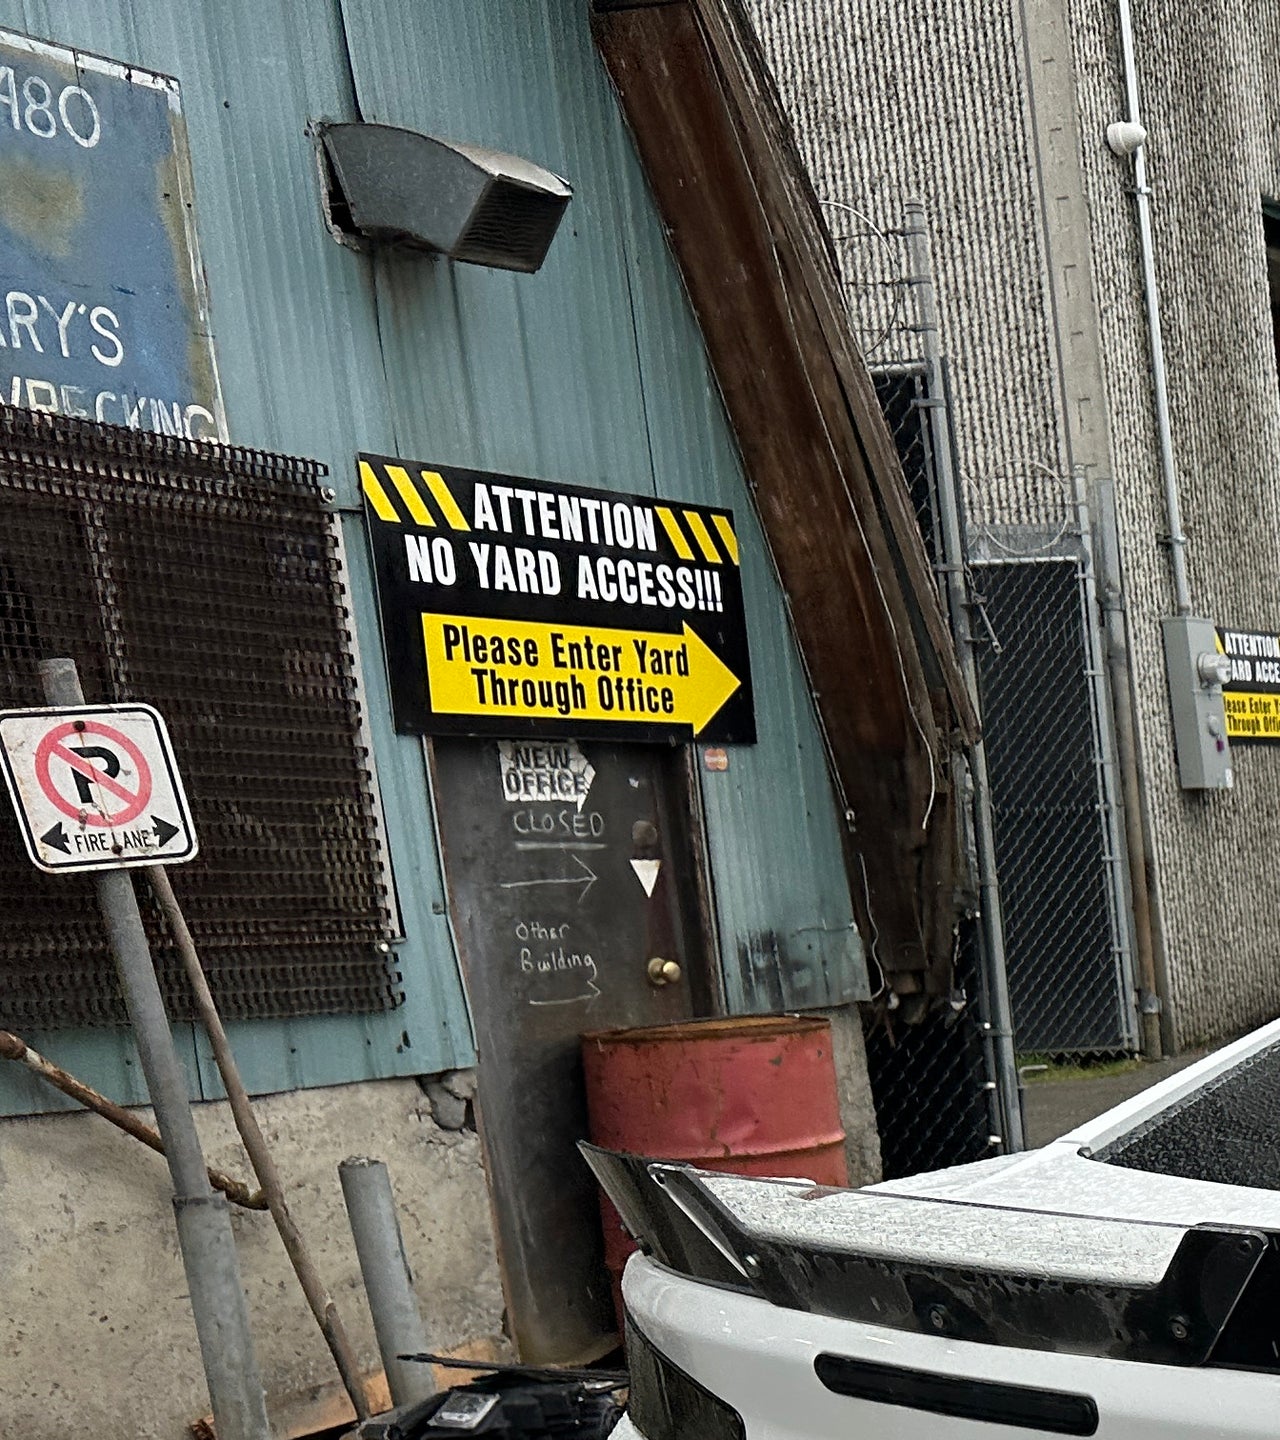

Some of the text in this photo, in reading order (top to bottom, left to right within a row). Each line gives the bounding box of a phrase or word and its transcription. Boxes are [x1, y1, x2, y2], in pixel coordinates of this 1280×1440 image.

[0, 291, 124, 367] RY'S
[474, 482, 658, 552] ATTENTION
[404, 534, 724, 613] NO YARD ACCESS!!!
[443, 623, 690, 677] Please Enter Yard
[1224, 632, 1280, 658] ATTENTION
[1231, 659, 1252, 682] ARD
[471, 668, 675, 715] Through Office
[1223, 697, 1247, 714] lease
[1249, 697, 1272, 714] Enter
[1227, 715, 1261, 735] Through
[515, 746, 571, 769] NEW
[504, 769, 589, 794] OFFICE
[513, 810, 604, 838] CLOSED
[74, 832, 110, 853] FIRE
[515, 921, 570, 941] Other
[520, 947, 598, 979] Building
